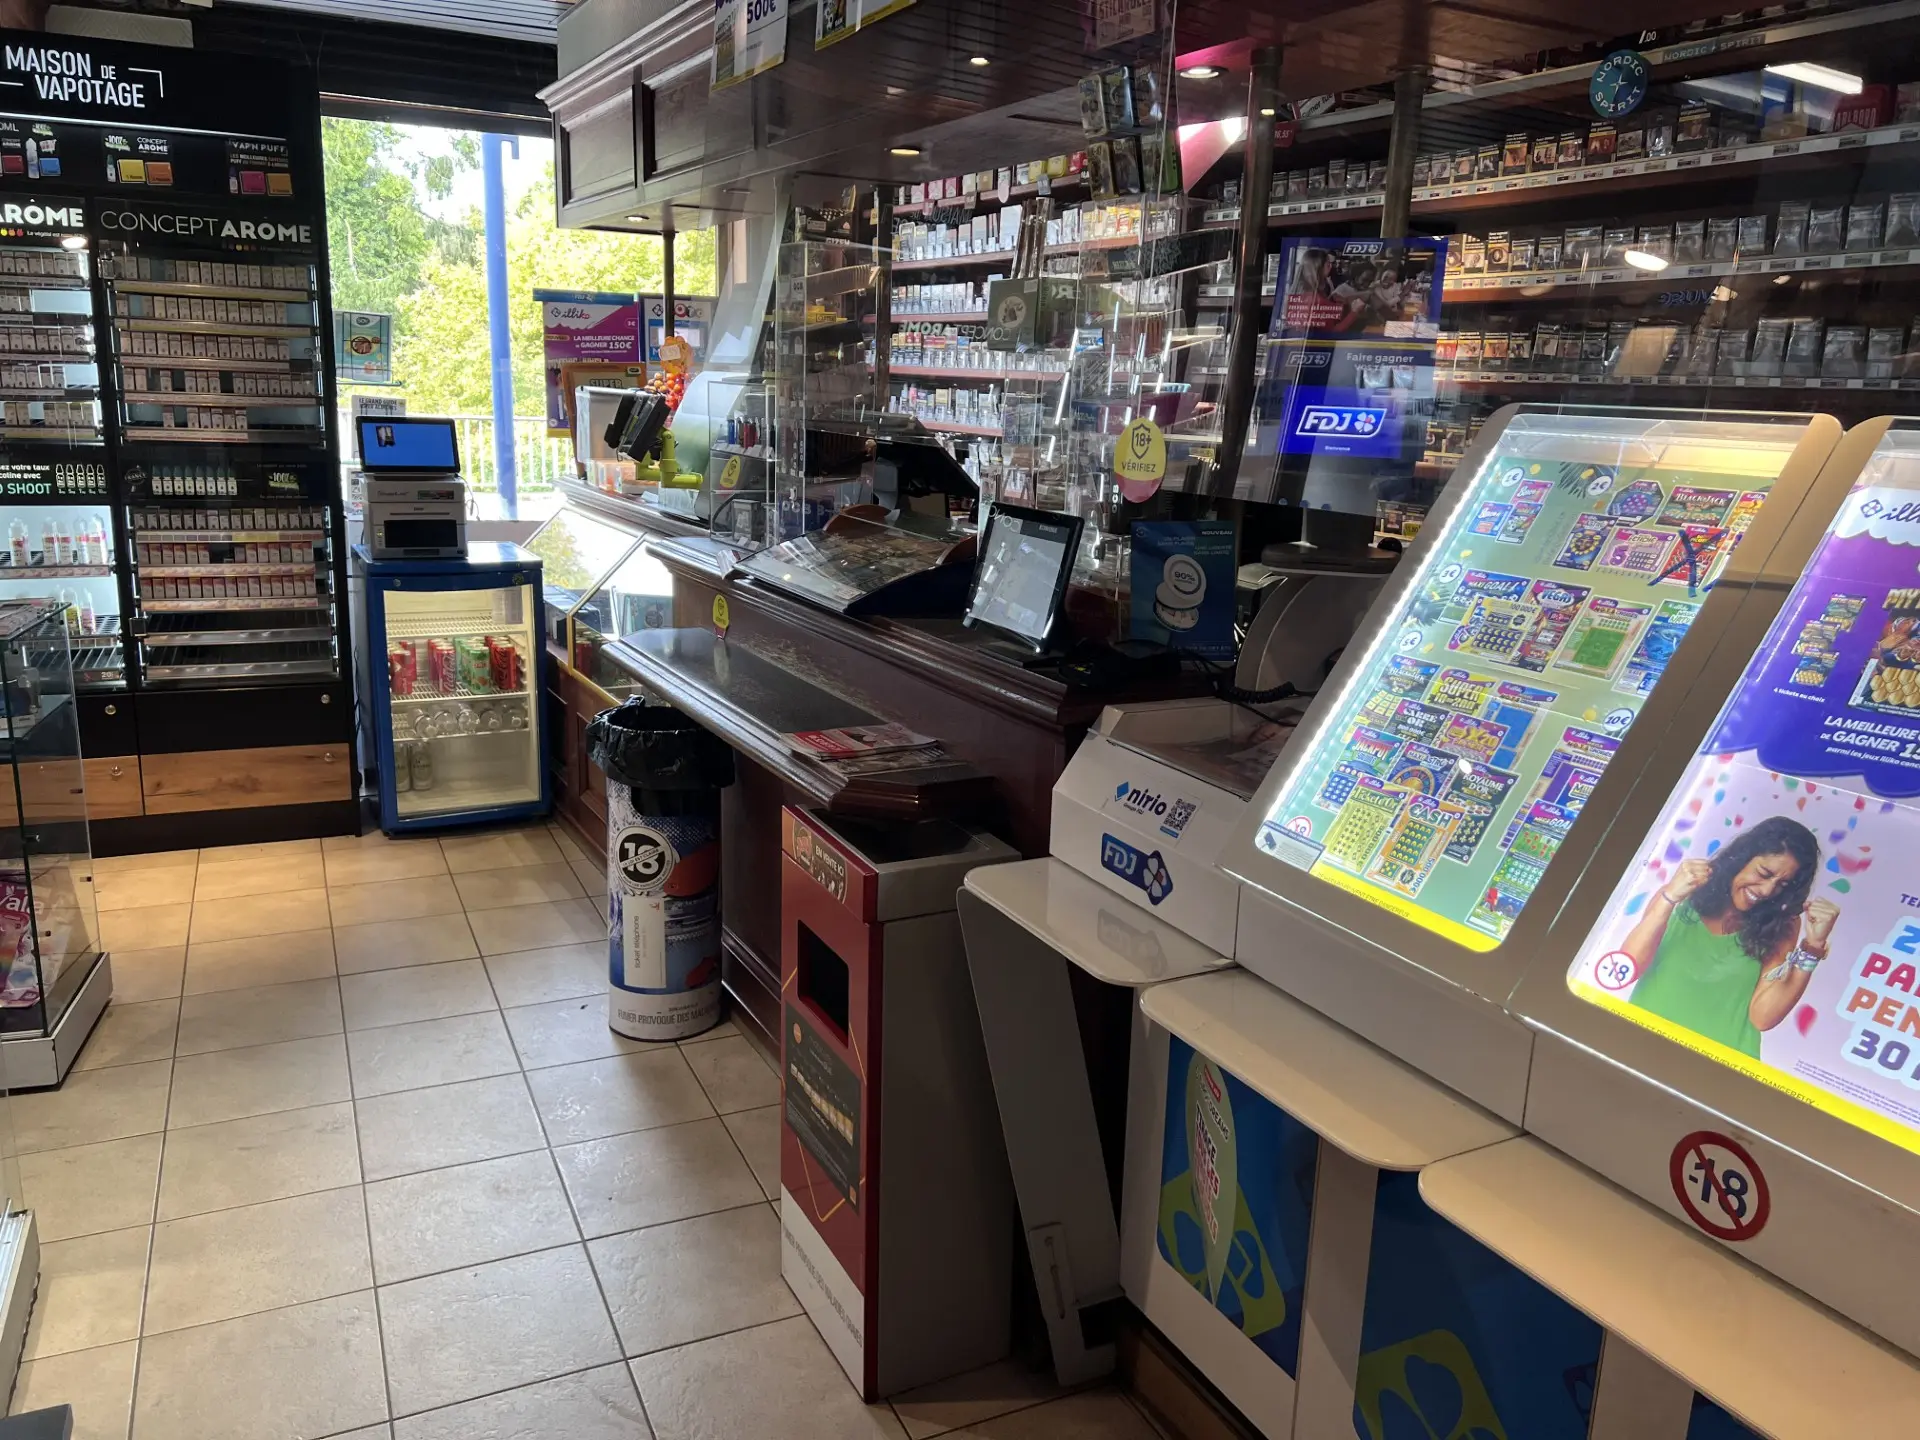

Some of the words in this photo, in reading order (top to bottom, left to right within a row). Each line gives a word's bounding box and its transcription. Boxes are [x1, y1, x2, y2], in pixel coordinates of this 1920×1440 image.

[1664, 45, 1707, 61] NORDIC
[1720, 36, 1763, 50] SPIRIT
[5, 45, 92, 78] MAISON
[100, 65, 117, 80] DE
[1597, 55, 1643, 82] NORDIC
[35, 74, 146, 108] VAPOTAGE
[1595, 87, 1640, 112] SPIRIT
[137, 136, 167, 145] CONCEPT
[101, 211, 218, 236] CONCEPT
[1346, 244, 1367, 254] FDJ
[562, 307, 590, 320] illiko
[1287, 311, 1309, 319] faire
[1310, 303, 1343, 311] aimons
[609, 341, 632, 349] 150€
[1288, 354, 1314, 365] FDJ
[1347, 353, 1372, 362] Faire
[1375, 354, 1413, 365] gagner
[1304, 411, 1352, 432] FDJ
[1134, 432, 1152, 448] 18+
[1121, 461, 1156, 473] VÉRIFIEZ
[7, 483, 52, 495] SHOOT
[1441, 568, 1457, 578] 3€
[1402, 634, 1418, 647] 5€
[1439, 683, 1480, 701] SUPER
[1808, 694, 1825, 703] choix
[1604, 714, 1631, 725] 10€
[1824, 715, 1842, 727] LA
[1843, 719, 1919, 740] MEILLEURE
[1833, 731, 1900, 751] GAGNER
[1825, 746, 1850, 755] parmi
[1862, 752, 1879, 760] jeux
[1463, 773, 1504, 791] ROYAUME
[1127, 788, 1168, 816] nirio
[1410, 804, 1452, 829] CASH
[624, 842, 659, 875] 18
[815, 845, 822, 858] EN
[823, 852, 837, 872] VENTE
[1104, 841, 1137, 875] FDJ
[1603, 961, 1629, 981] -18
[618, 1009, 637, 1022] FUMER
[638, 1013, 676, 1025] PROVOQUE
[677, 1013, 690, 1022] DES
[1851, 1029, 1910, 1071] 30
[1763, 1078, 1816, 1106] DANGEREUX
[1688, 1158, 1748, 1219] -18
